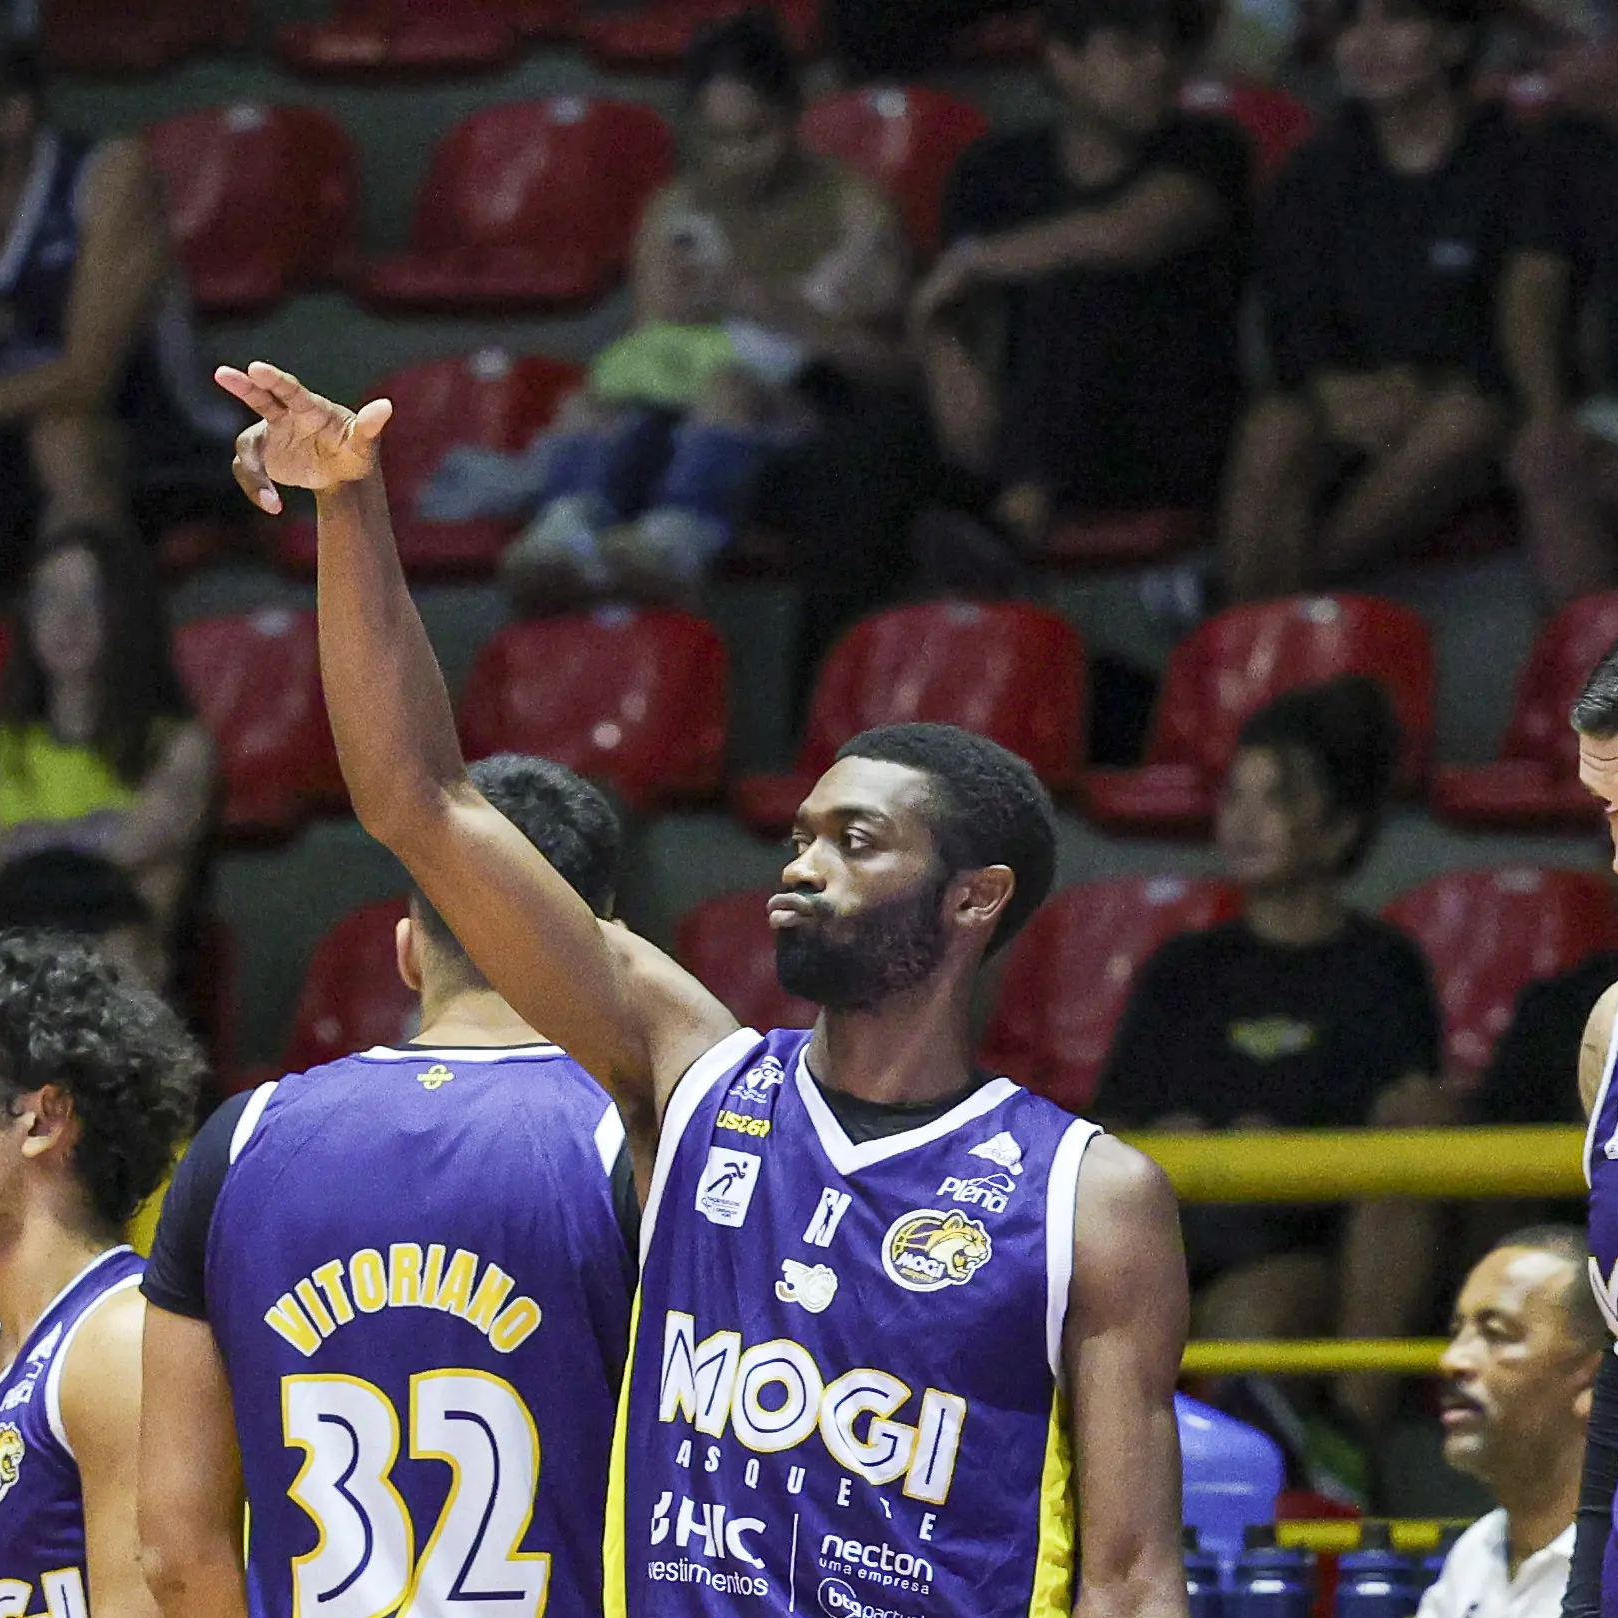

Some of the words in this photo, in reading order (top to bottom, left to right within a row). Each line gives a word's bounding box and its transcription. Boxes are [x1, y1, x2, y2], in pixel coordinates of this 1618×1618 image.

[895, 1251, 945, 1278] MOGI
[264, 1242, 541, 1357] VITORIANO
[658, 1309, 967, 1505] MOGI
[819, 1557, 853, 1576] uma
[857, 1568, 930, 1595] empresa
[821, 1534, 933, 1582] necton
